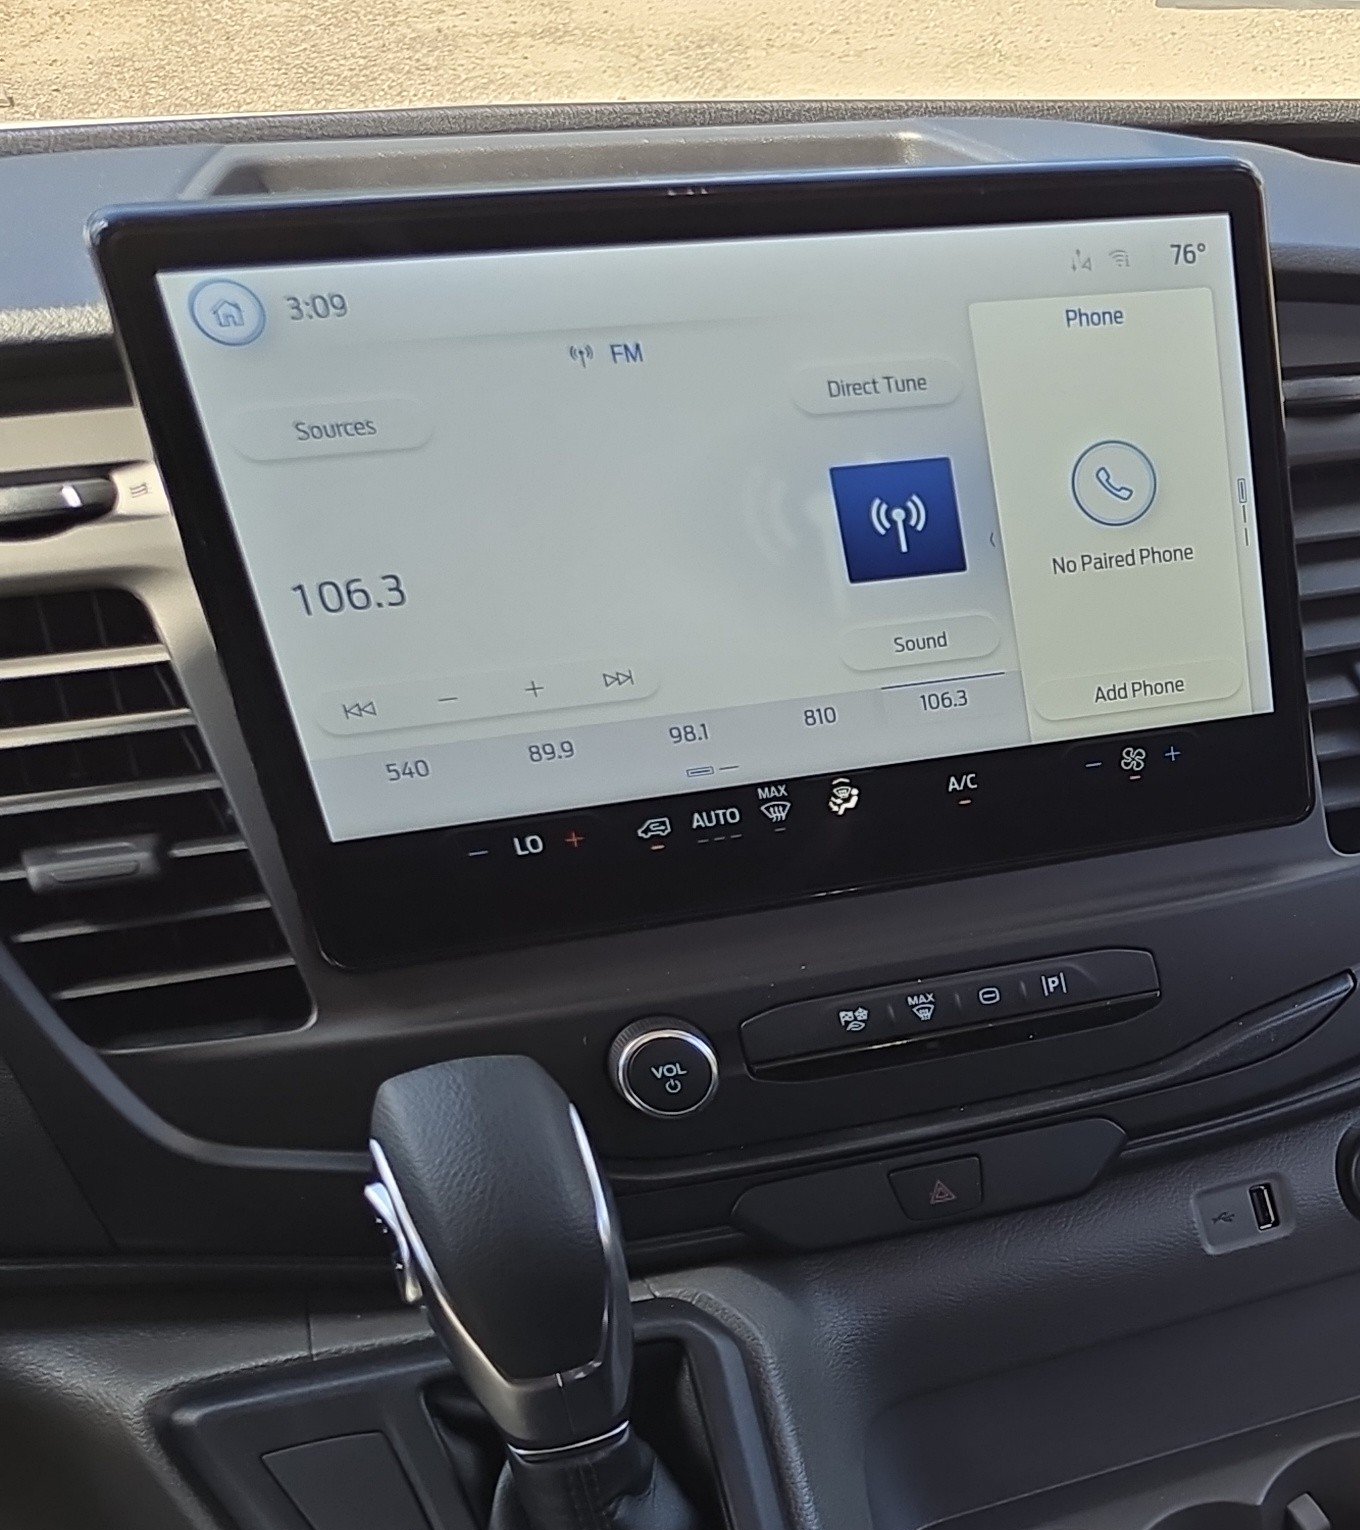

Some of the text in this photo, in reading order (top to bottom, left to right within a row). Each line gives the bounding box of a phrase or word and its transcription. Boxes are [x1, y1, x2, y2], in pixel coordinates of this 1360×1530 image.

[288, 292, 348, 322] 3:09
[1065, 308, 1125, 328] Phone
[610, 341, 644, 365] FM
[827, 373, 928, 398] Direct Tune
[295, 416, 378, 442] Sources
[1052, 544, 1194, 575] No Paired Phone
[291, 573, 408, 618] 106.3
[894, 631, 948, 653] Sound
[919, 689, 968, 712] 106.3
[1094, 676, 1185, 703] Add Phone
[803, 706, 837, 727] 810
[668, 722, 709, 744] 98.1
[528, 739, 575, 764] 89.9
[385, 758, 431, 782] 540
[757, 784, 788, 800] MAX
[947, 773, 978, 793] A/C
[691, 806, 741, 830] AUTO
[513, 834, 544, 856] LO
[907, 992, 935, 1007] MAX
[651, 1061, 687, 1079] VOL
